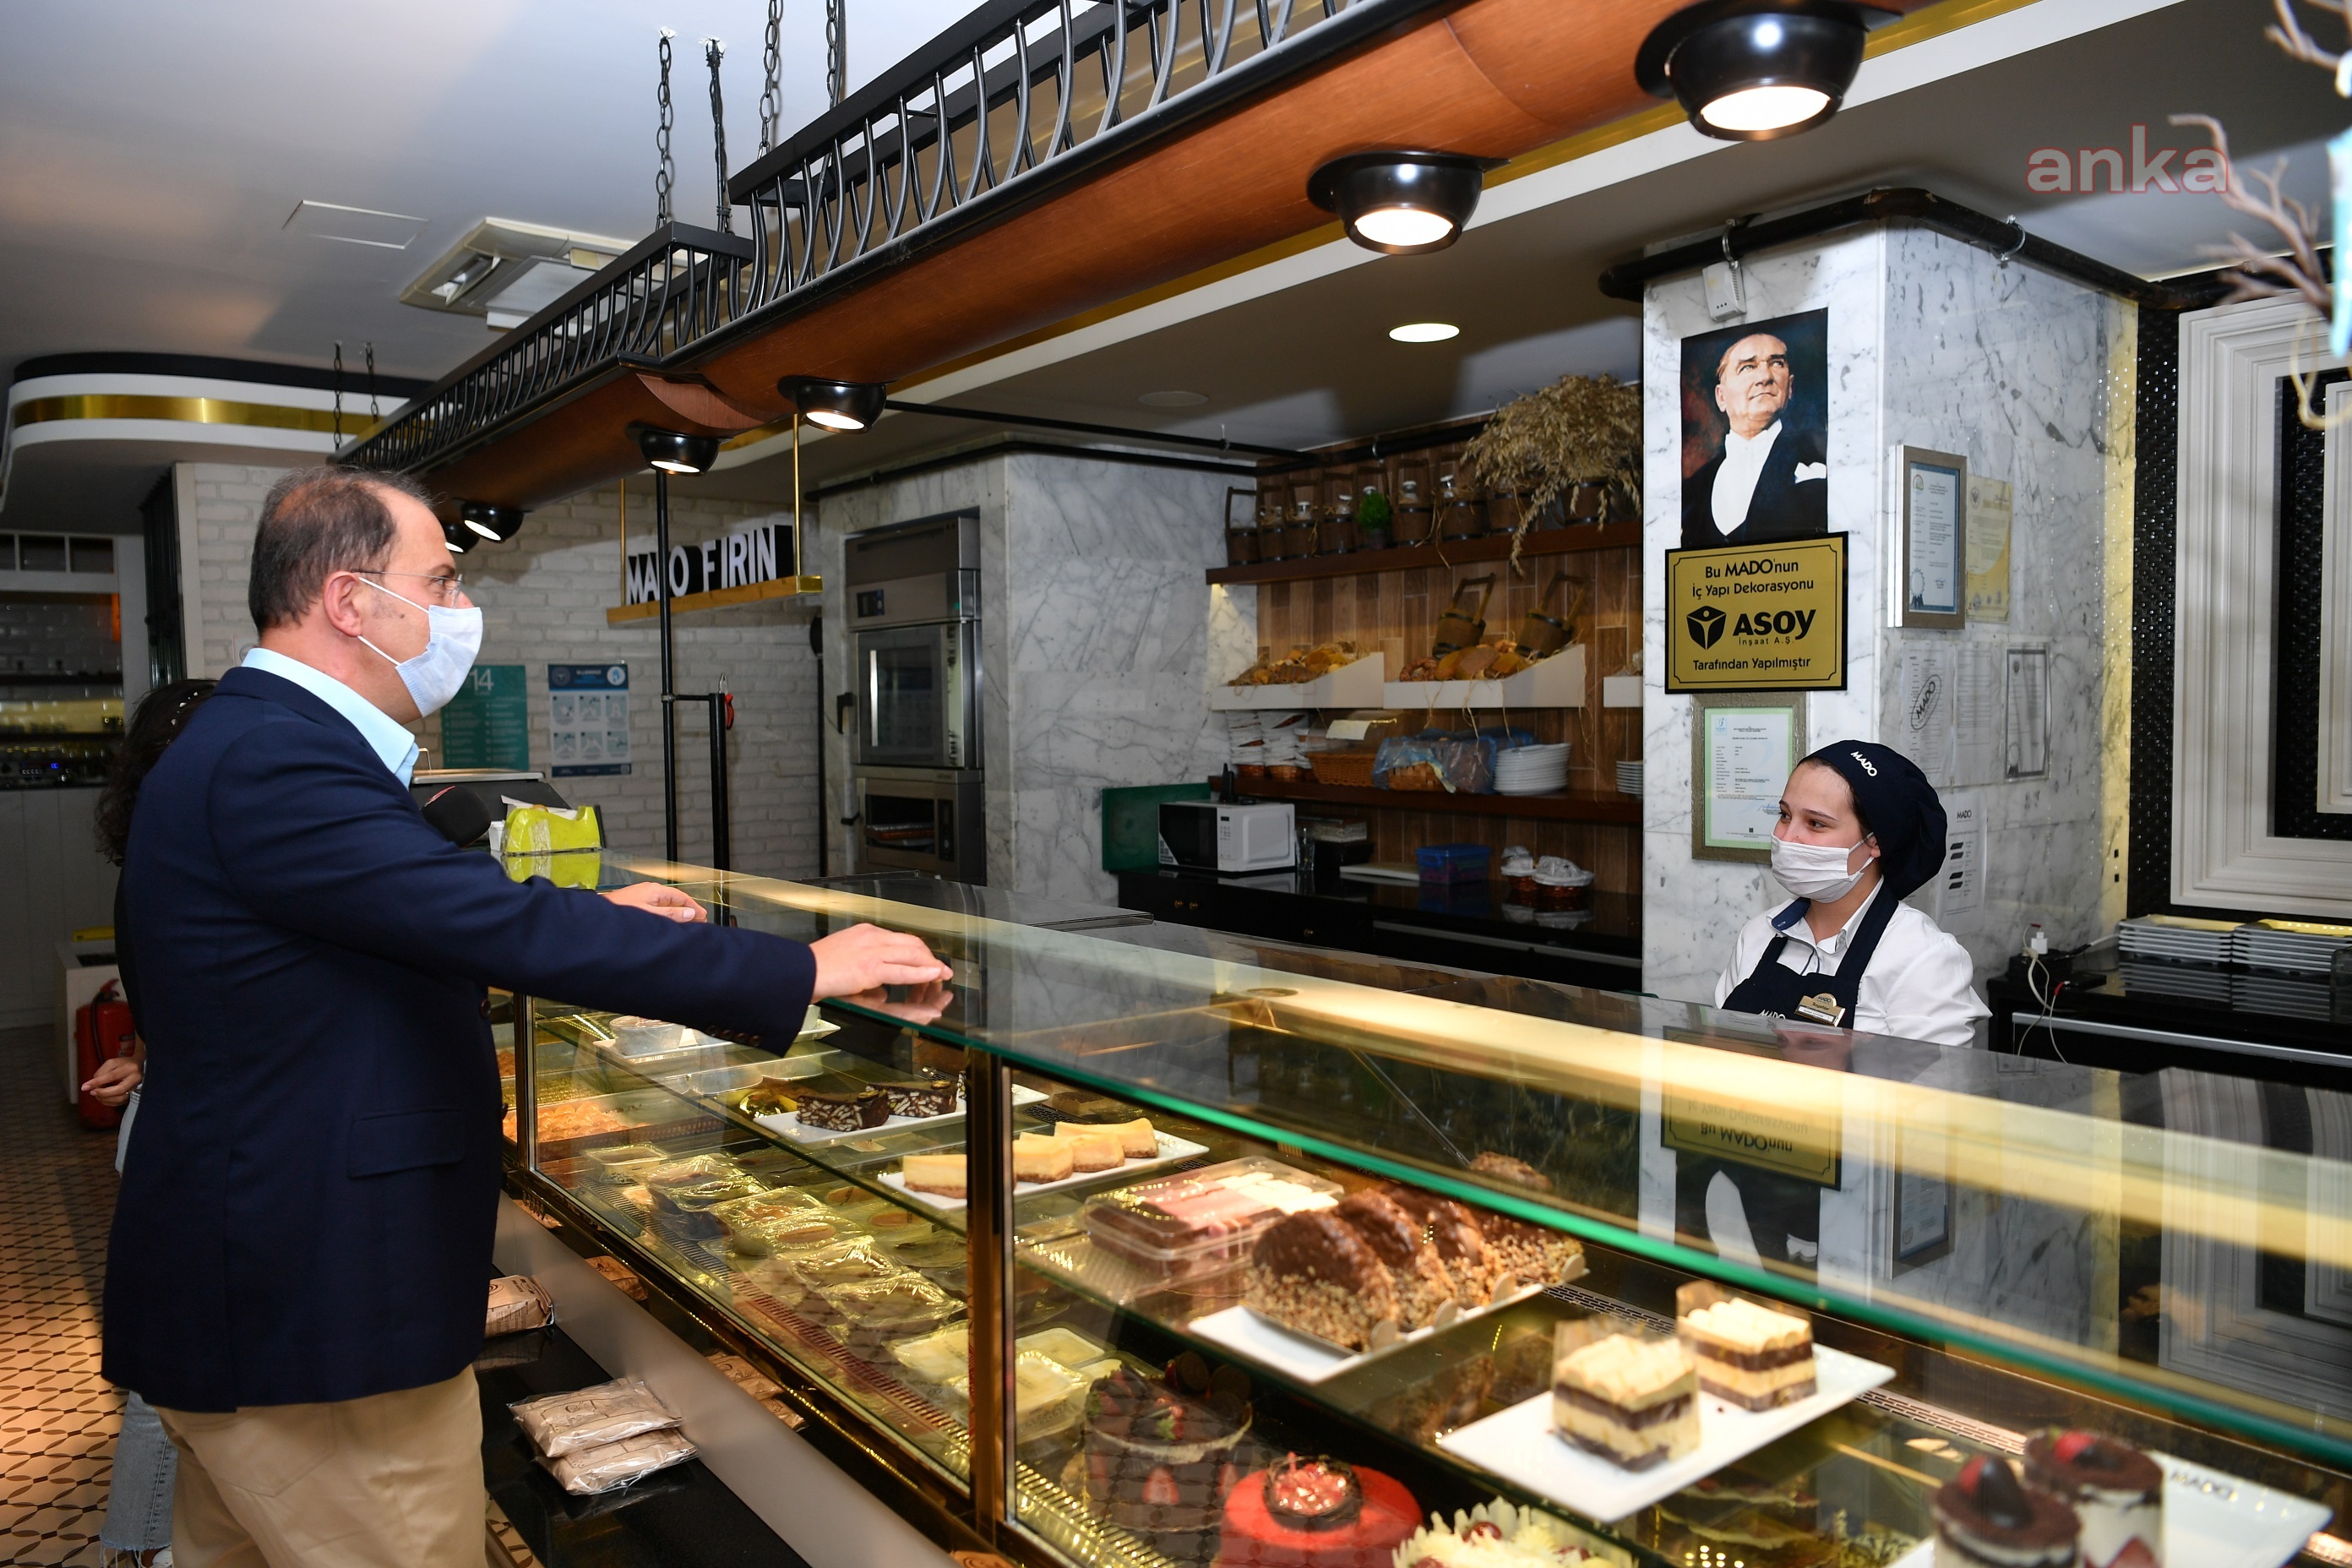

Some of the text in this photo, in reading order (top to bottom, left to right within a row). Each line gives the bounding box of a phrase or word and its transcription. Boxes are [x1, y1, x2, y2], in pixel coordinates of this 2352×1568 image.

[626, 525, 776, 605] MAO FIRIN
[1705, 558, 1799, 579] Bu MADO'nun
[1692, 580, 1814, 600] İç Yapı Dekorasyonu
[1693, 656, 1811, 671] Tarafından Yapılmıştır
[469, 668, 494, 691] 14
[1916, 681, 1936, 719] MADO
[1850, 751, 1877, 776] MADO
[1957, 809, 1972, 819] MADO
